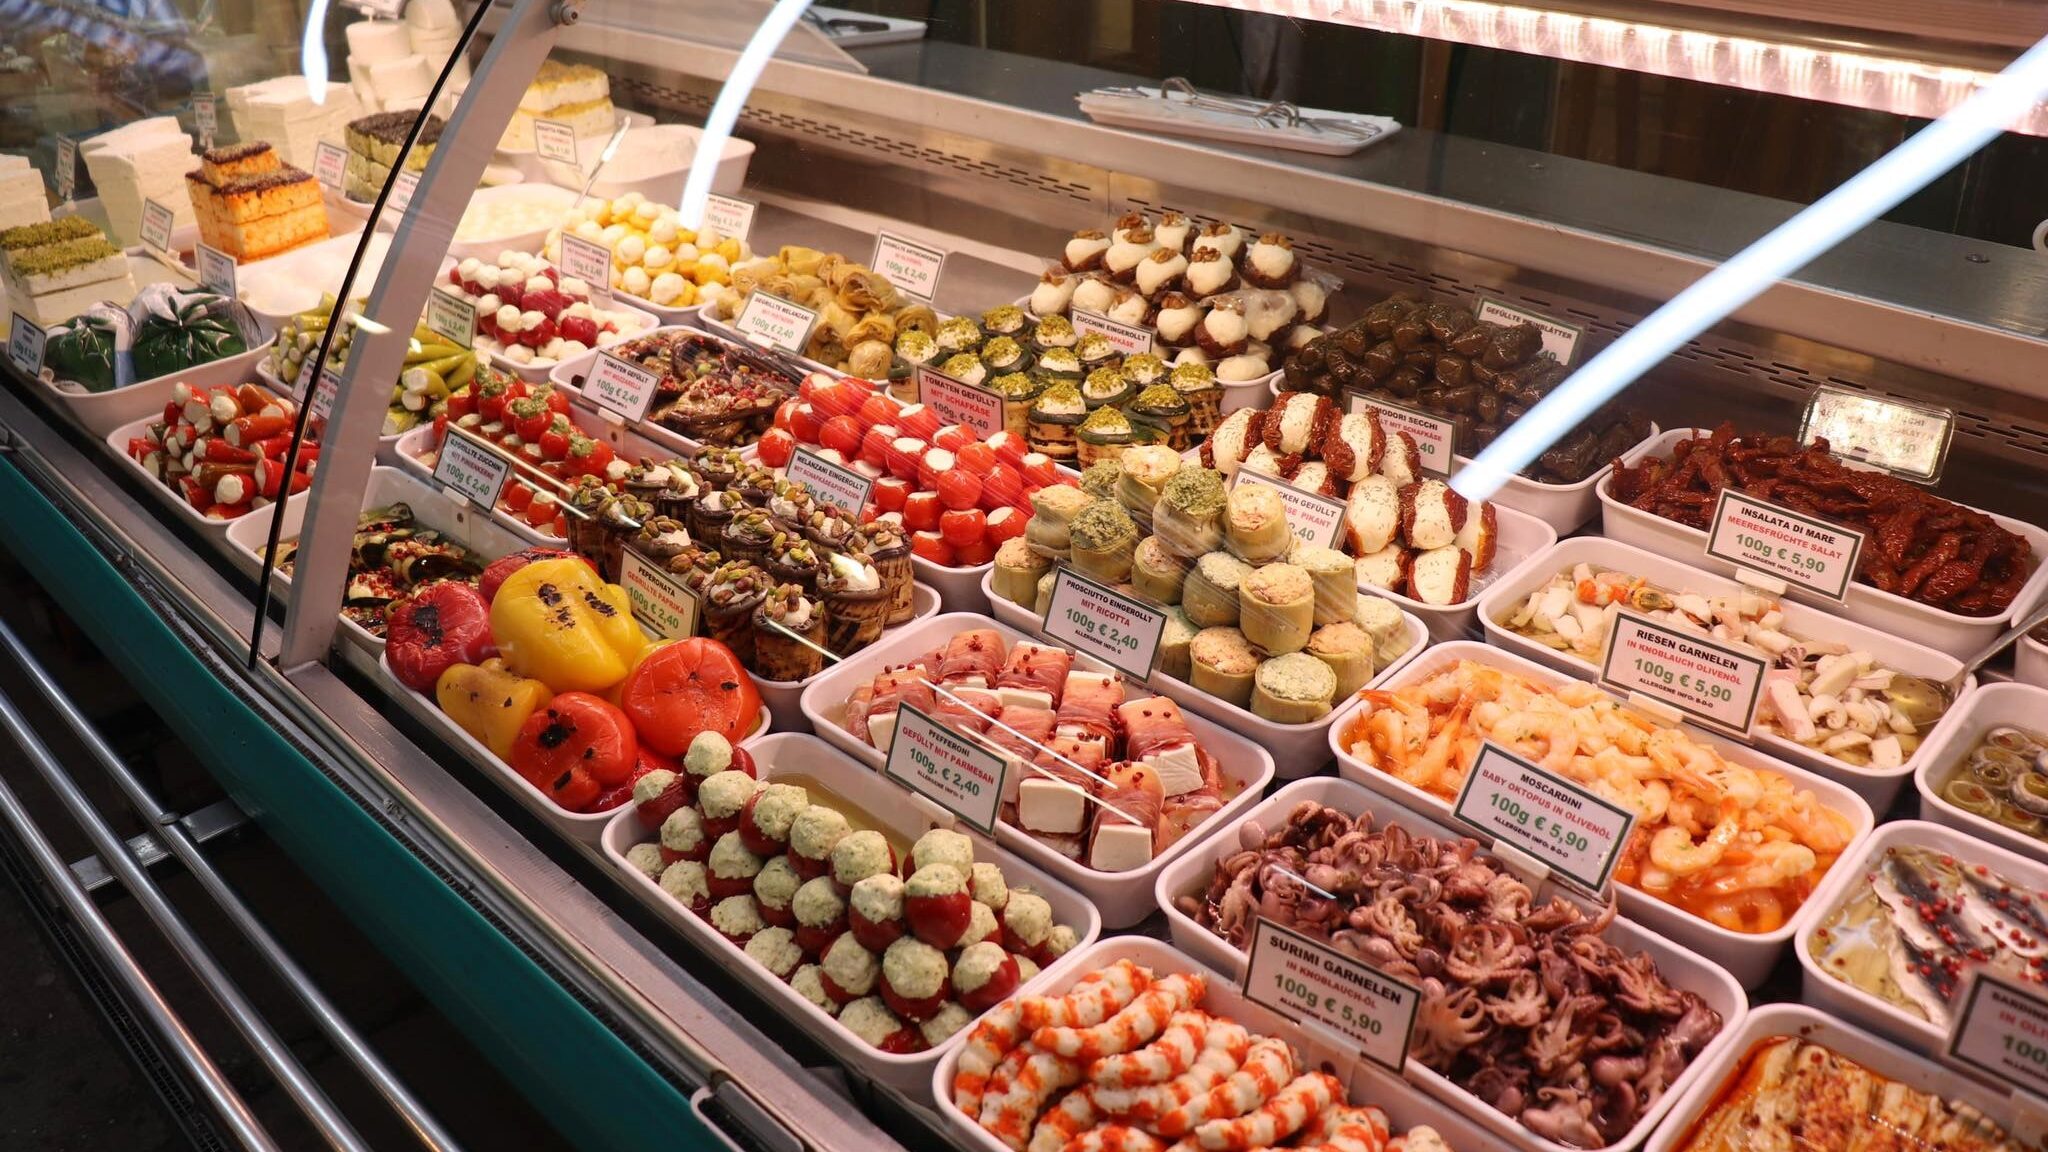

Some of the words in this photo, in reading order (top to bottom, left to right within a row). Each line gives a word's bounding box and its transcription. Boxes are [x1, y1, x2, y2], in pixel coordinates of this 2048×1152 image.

[886, 260, 903, 274] 100g
[905, 267, 909, 275] €
[911, 269, 927, 281] 2,40
[752, 317, 769, 331] 100g
[777, 325, 794, 339] 2,40
[1077, 315, 1105, 329] ZUCCHINI
[1107, 325, 1146, 341] EINGEROLLT
[1487, 306, 1520, 323] GEFÜLLTE
[604, 359, 626, 373] TOMATEN
[627, 370, 648, 383] GEFÜLLT
[597, 379, 614, 395] 100g
[616, 388, 621, 396] €
[622, 391, 639, 404] 2,40
[924, 375, 959, 394] TOMATEN
[962, 389, 995, 408] GEFÜLLT
[931, 389, 943, 399] MIT
[946, 394, 990, 417] SCHAFKÄSE
[934, 402, 957, 418] 100g.
[960, 412, 966, 421] €
[968, 416, 988, 429] 2,40
[1409, 416, 1438, 430] SECCHI
[1403, 425, 1442, 441] SCHAFKÄSE
[450, 439, 477, 458] GEGRILLTE
[477, 454, 502, 472] ZUCCHINI
[446, 463, 464, 482] 100g
[467, 475, 472, 484] €
[472, 479, 490, 495] 2,40
[797, 455, 828, 474] MELANZANI
[829, 470, 864, 490] EINGEROLLT
[1300, 499, 1336, 518] GEFÜLLT
[1301, 513, 1331, 528] PIKANT
[1727, 515, 1809, 549] MEERESFRÜCHTE
[1810, 543, 1843, 560] SALAT
[1741, 507, 1790, 530] INSALATA
[1792, 524, 1803, 534] DI
[1805, 528, 1835, 545] MARE
[1736, 533, 1772, 557] 100g
[1777, 548, 1787, 560] €
[1791, 552, 1825, 573] 5,90
[1742, 552, 1776, 568] ALLERGENE
[628, 571, 657, 598] GEGRILLTE
[658, 593, 684, 615] PAPRIKA
[638, 566, 675, 597] PEPERONATA
[629, 586, 648, 611] 100g
[651, 604, 657, 614] €
[658, 609, 679, 629] 2,40
[1066, 580, 1109, 603] PROSCIUTTO
[1109, 599, 1153, 623] EINGEROLLT
[1081, 598, 1095, 610] MIT
[1096, 605, 1130, 627] RICOTTA
[1066, 608, 1095, 632] 100g
[1099, 623, 1108, 636] €
[1109, 628, 1138, 650] 2,40
[1075, 629, 1103, 648] ALLERGENE
[1627, 639, 1637, 648] IN
[1639, 644, 1694, 668] KNOBLAUCH
[1697, 664, 1742, 685] OLIVENÖL
[1636, 629, 1676, 649] RIESEN
[1679, 644, 1739, 671] GARNELEN
[1635, 658, 1674, 685] 100g
[1680, 674, 1690, 687] €
[1695, 679, 1732, 702] 5,90
[1639, 678, 1676, 695] ALLERGENE
[1677, 691, 1695, 701] INFO:
[903, 726, 934, 751] GEFÜLLT
[935, 746, 949, 759] MIT
[950, 754, 994, 785] PARMESAN
[928, 728, 970, 757] PFEFFERONI
[910, 748, 937, 775] 100g.
[942, 768, 951, 781] €
[952, 772, 980, 796] 2,40
[1482, 769, 1508, 787] BABY
[1508, 782, 1551, 810] OKTOPUS
[1552, 805, 1563, 816] IN
[1565, 811, 1611, 840] OLIVENÖL
[1520, 774, 1582, 810] MOSCARDINI
[1490, 792, 1530, 825] 100g
[1535, 816, 1546, 831] €
[1549, 825, 1588, 852] 5,90
[1494, 816, 1531, 839] ALLERGENE
[1531, 835, 1549, 849] INFO:
[1270, 935, 1320, 966] SURIMI
[1323, 960, 1402, 1005] GARNELEN
[1286, 960, 1297, 971] IN
[1300, 965, 1377, 1009] KNOBLAUCH-ÖL
[1275, 973, 1318, 1008] 100g
[1325, 998, 1336, 1013] €
[1341, 1005, 1382, 1035] 5,90
[1999, 1010, 2016, 1024] IN
